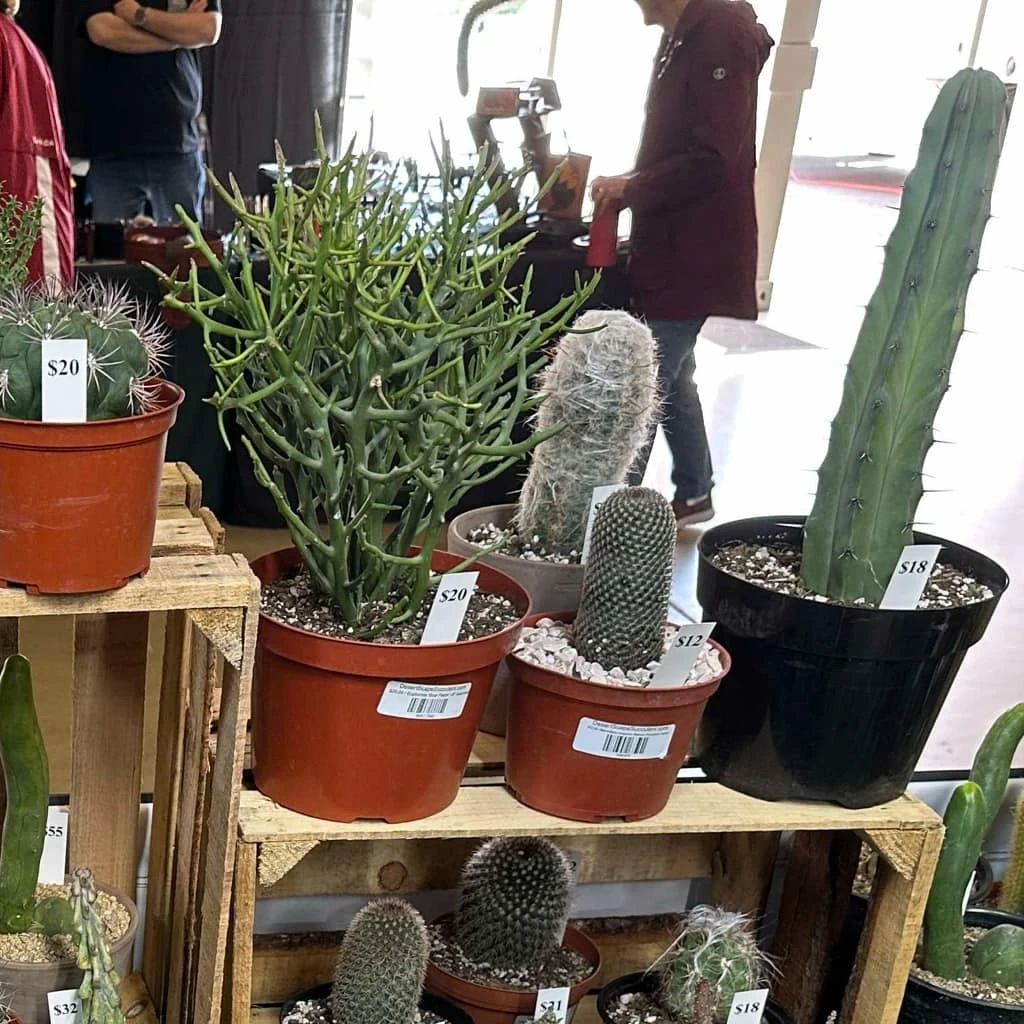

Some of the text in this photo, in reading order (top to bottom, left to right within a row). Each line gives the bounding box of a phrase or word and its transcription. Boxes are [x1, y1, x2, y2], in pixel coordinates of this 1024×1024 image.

[47, 358, 80, 377] $20
[898, 557, 928, 576] $18
[439, 585, 468, 603] $20
[675, 633, 704, 649] $12
[53, 1002, 78, 1016] $32
[733, 1001, 760, 1016] $18
